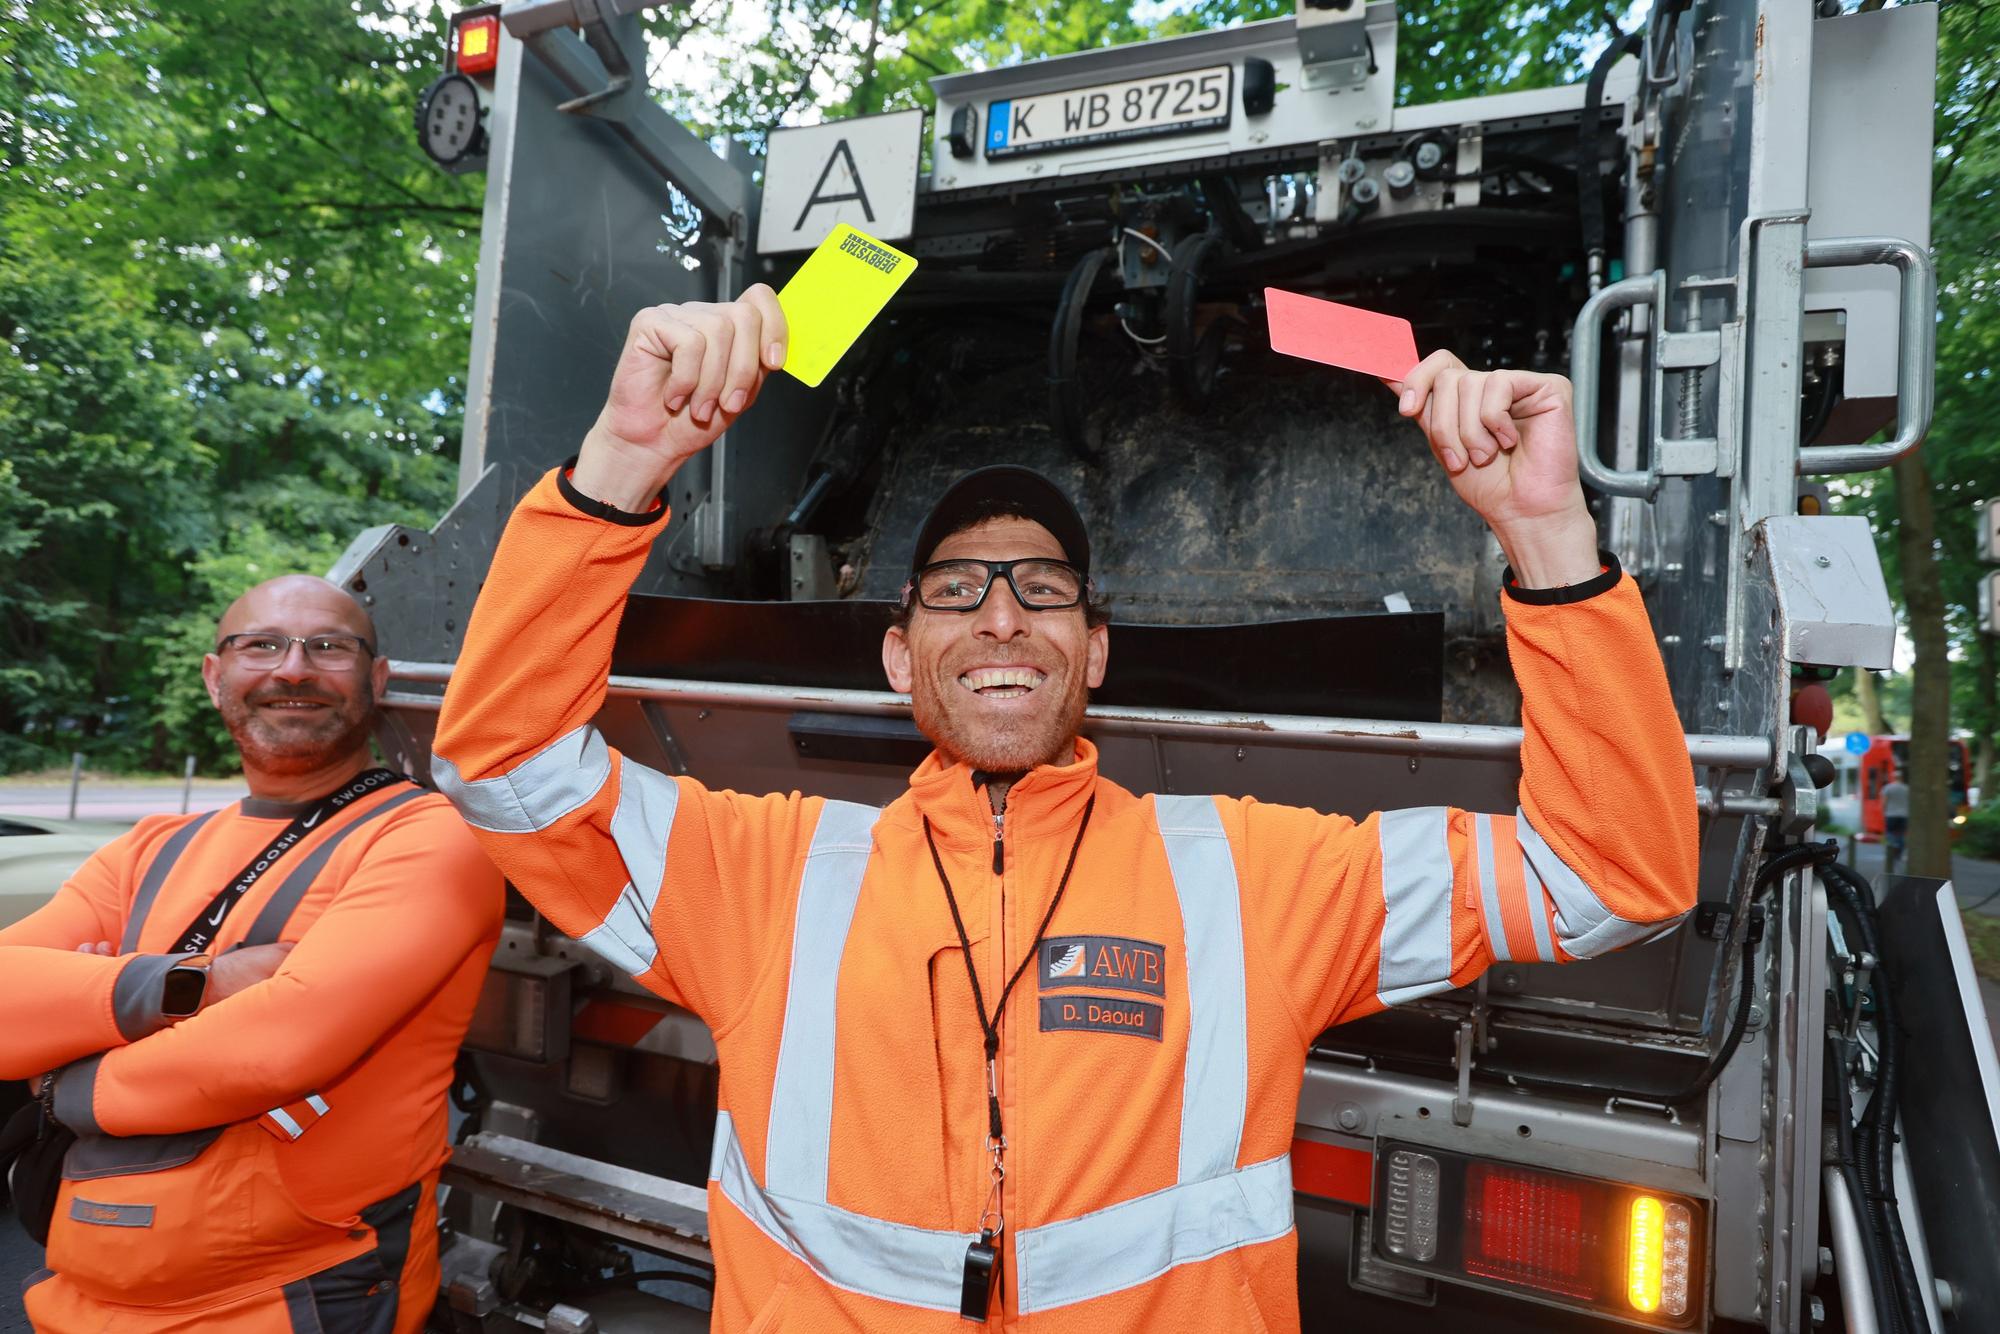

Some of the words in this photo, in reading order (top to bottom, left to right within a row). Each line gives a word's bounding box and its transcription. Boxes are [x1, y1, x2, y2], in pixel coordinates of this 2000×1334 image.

[1012, 103, 1035, 140] K
[1064, 93, 1110, 133] WB
[1122, 74, 1223, 123] 8725
[792, 138, 876, 232] A
[839, 238, 897, 275] DERBYSTAR
[331, 771, 395, 806] SWOOSH
[235, 832, 298, 893] SWOOSH
[1090, 944, 1160, 984] AWB
[1063, 1004, 1082, 1021] D.
[1088, 1005, 1145, 1027] Daoud
